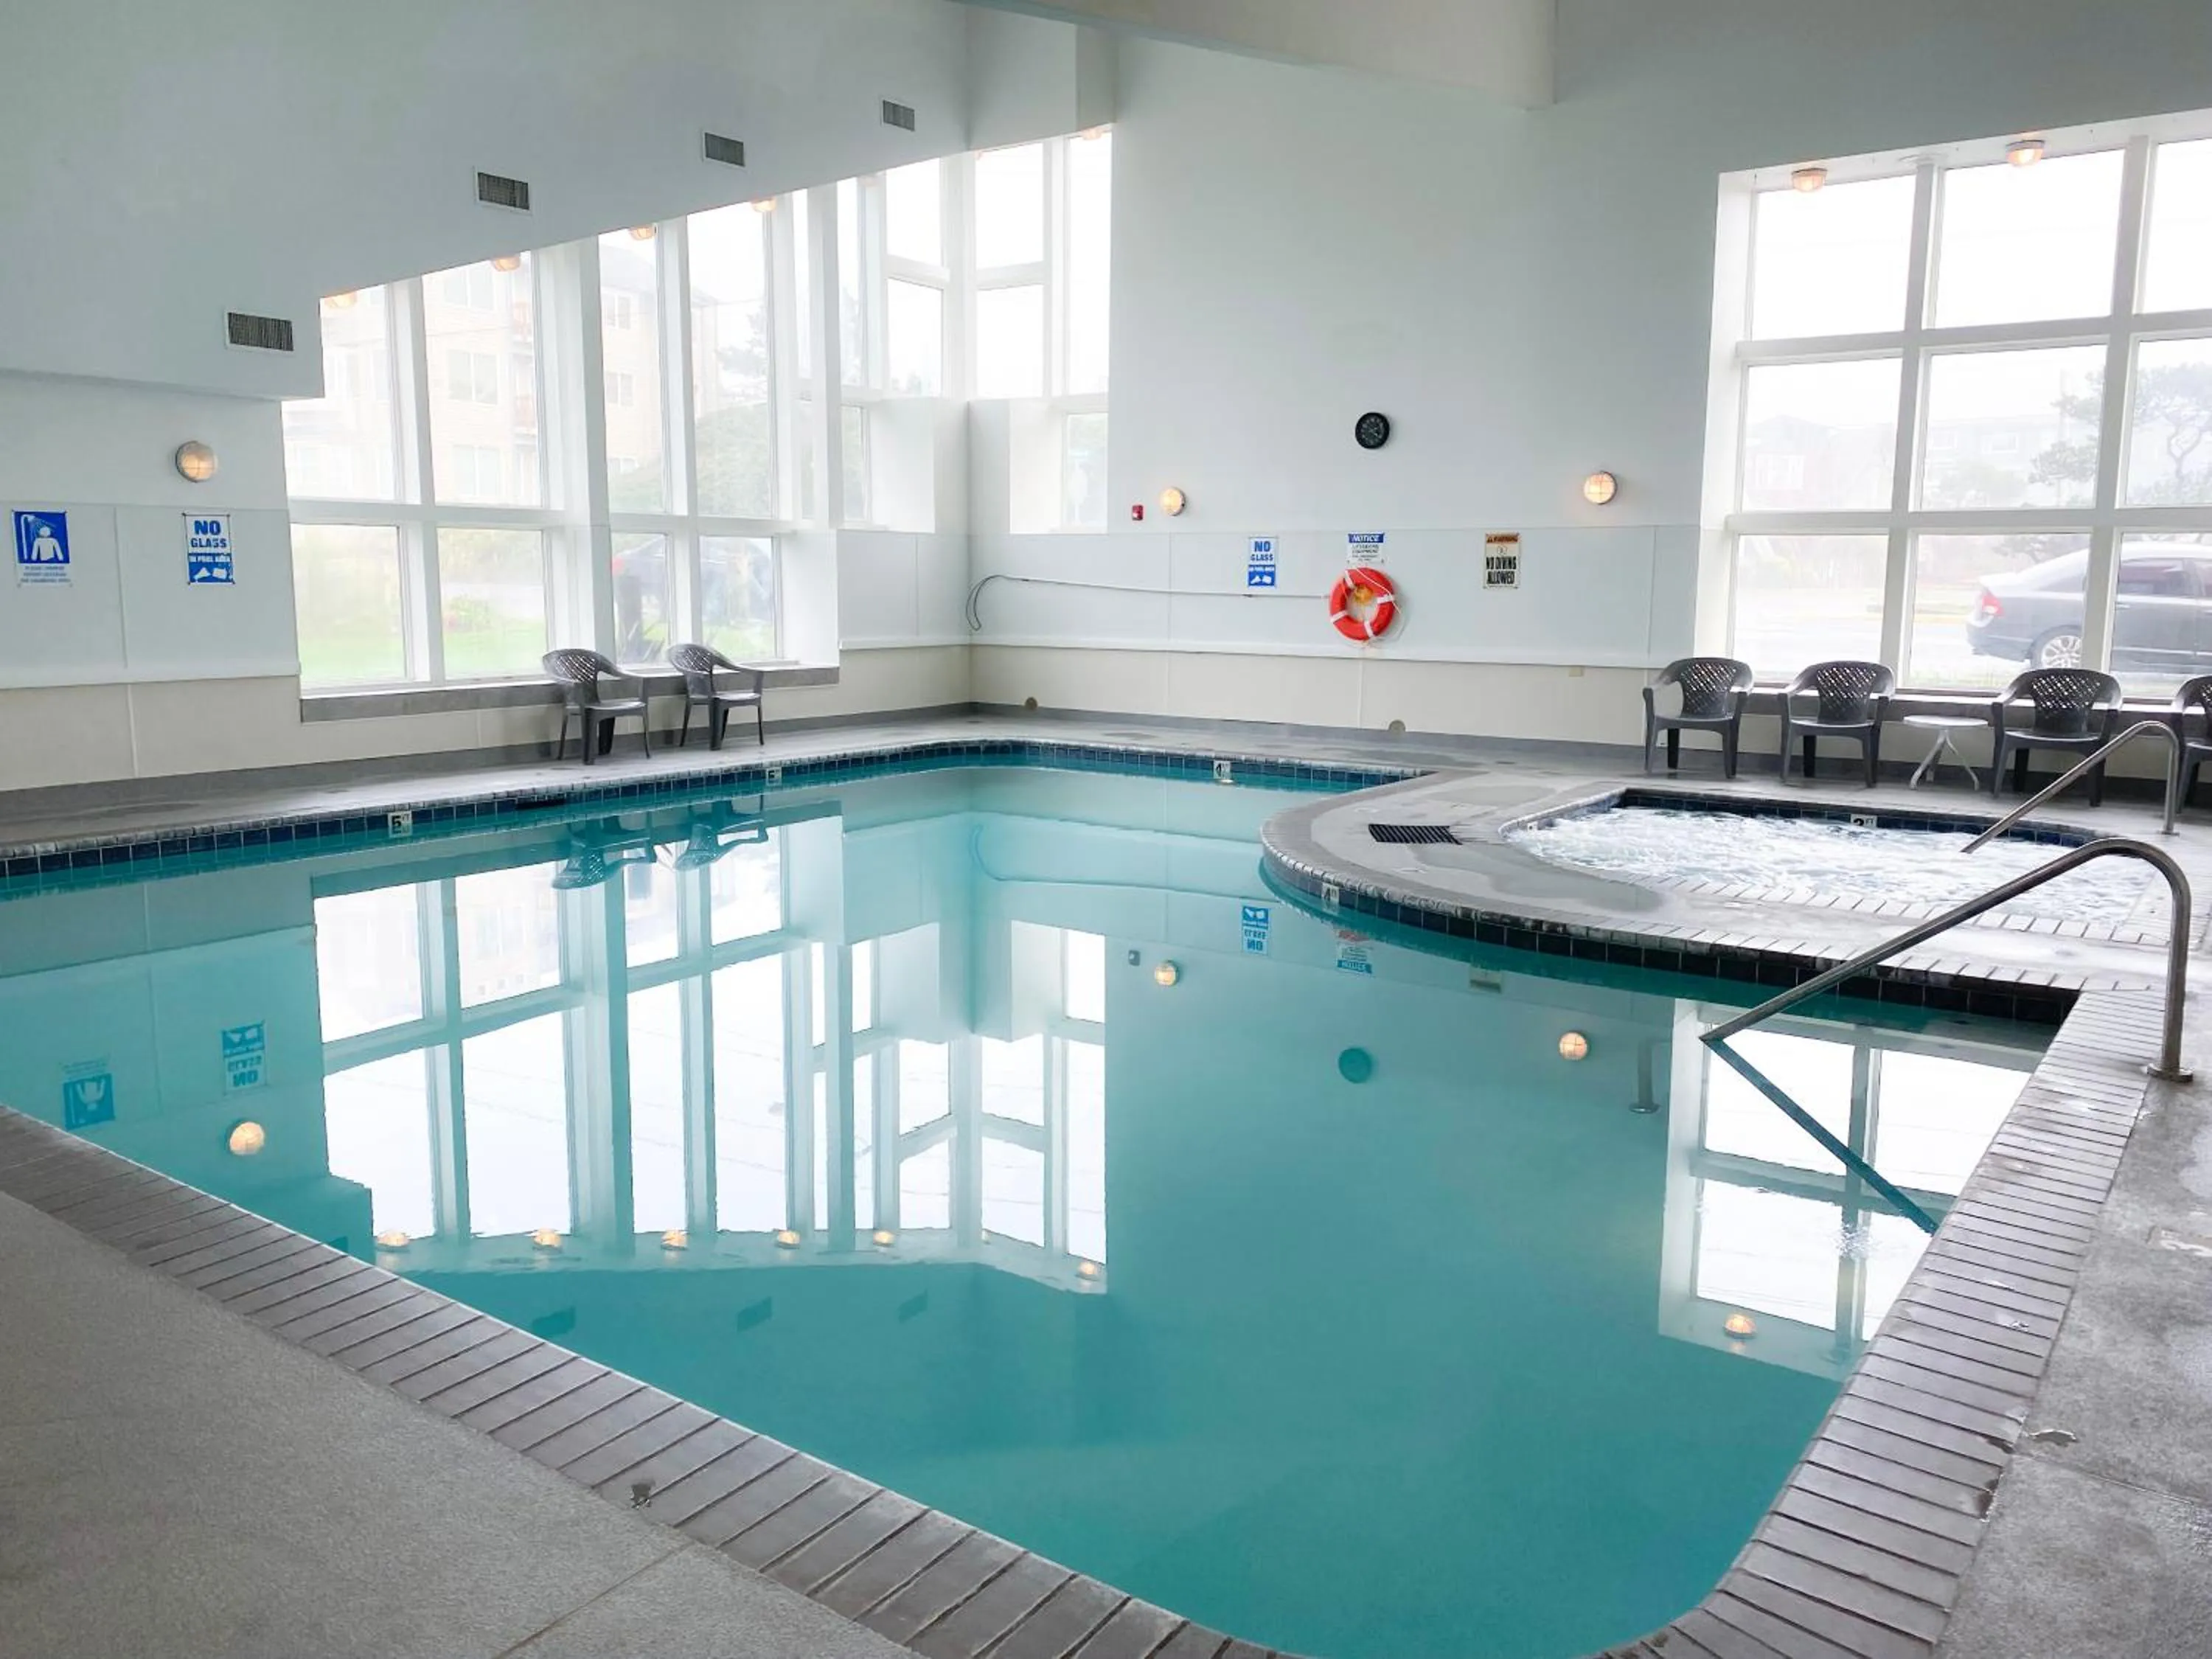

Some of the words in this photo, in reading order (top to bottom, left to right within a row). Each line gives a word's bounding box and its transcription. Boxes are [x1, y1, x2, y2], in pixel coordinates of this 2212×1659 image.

[194, 520, 221, 535] NO
[191, 538, 227, 548] GLASS
[1254, 541, 1270, 552] NO
[1486, 571, 1515, 585] ALLOWED
